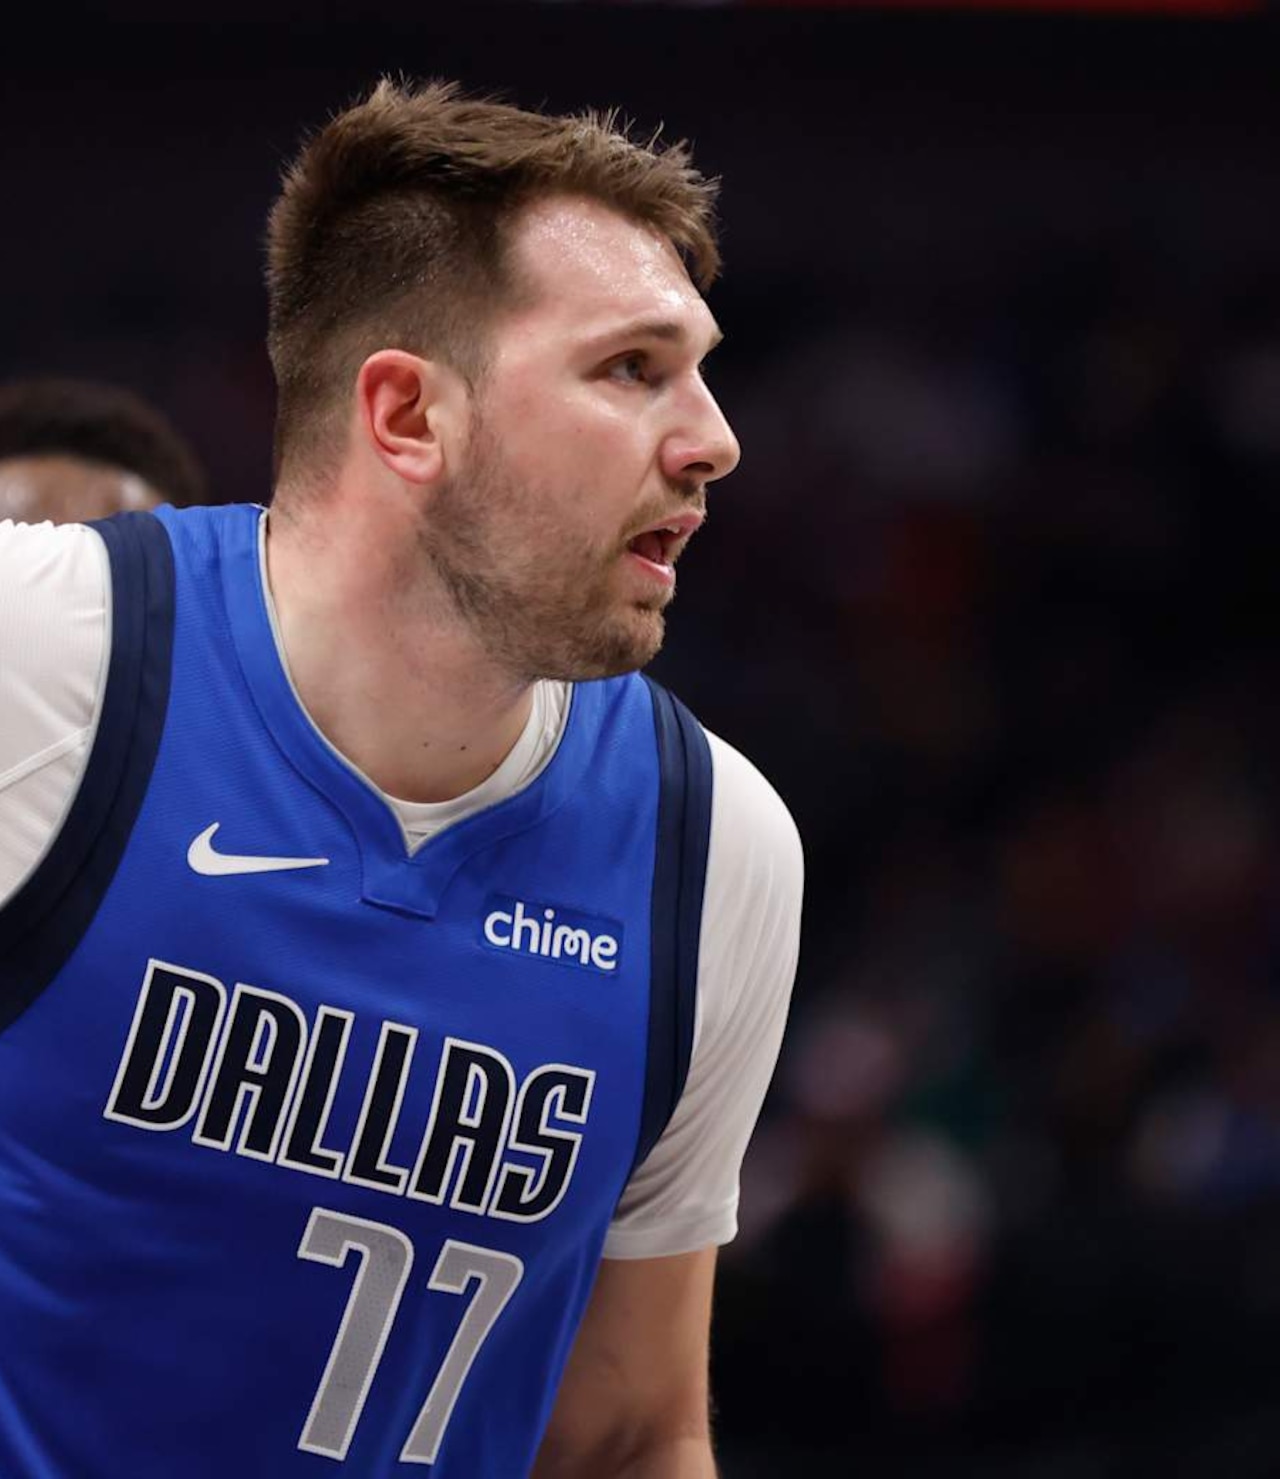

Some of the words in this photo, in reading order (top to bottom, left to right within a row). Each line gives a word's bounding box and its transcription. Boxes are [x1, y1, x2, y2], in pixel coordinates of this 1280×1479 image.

[483, 903, 617, 970] chime
[104, 957, 596, 1223] DALLAS
[297, 1207, 525, 1464] 77
